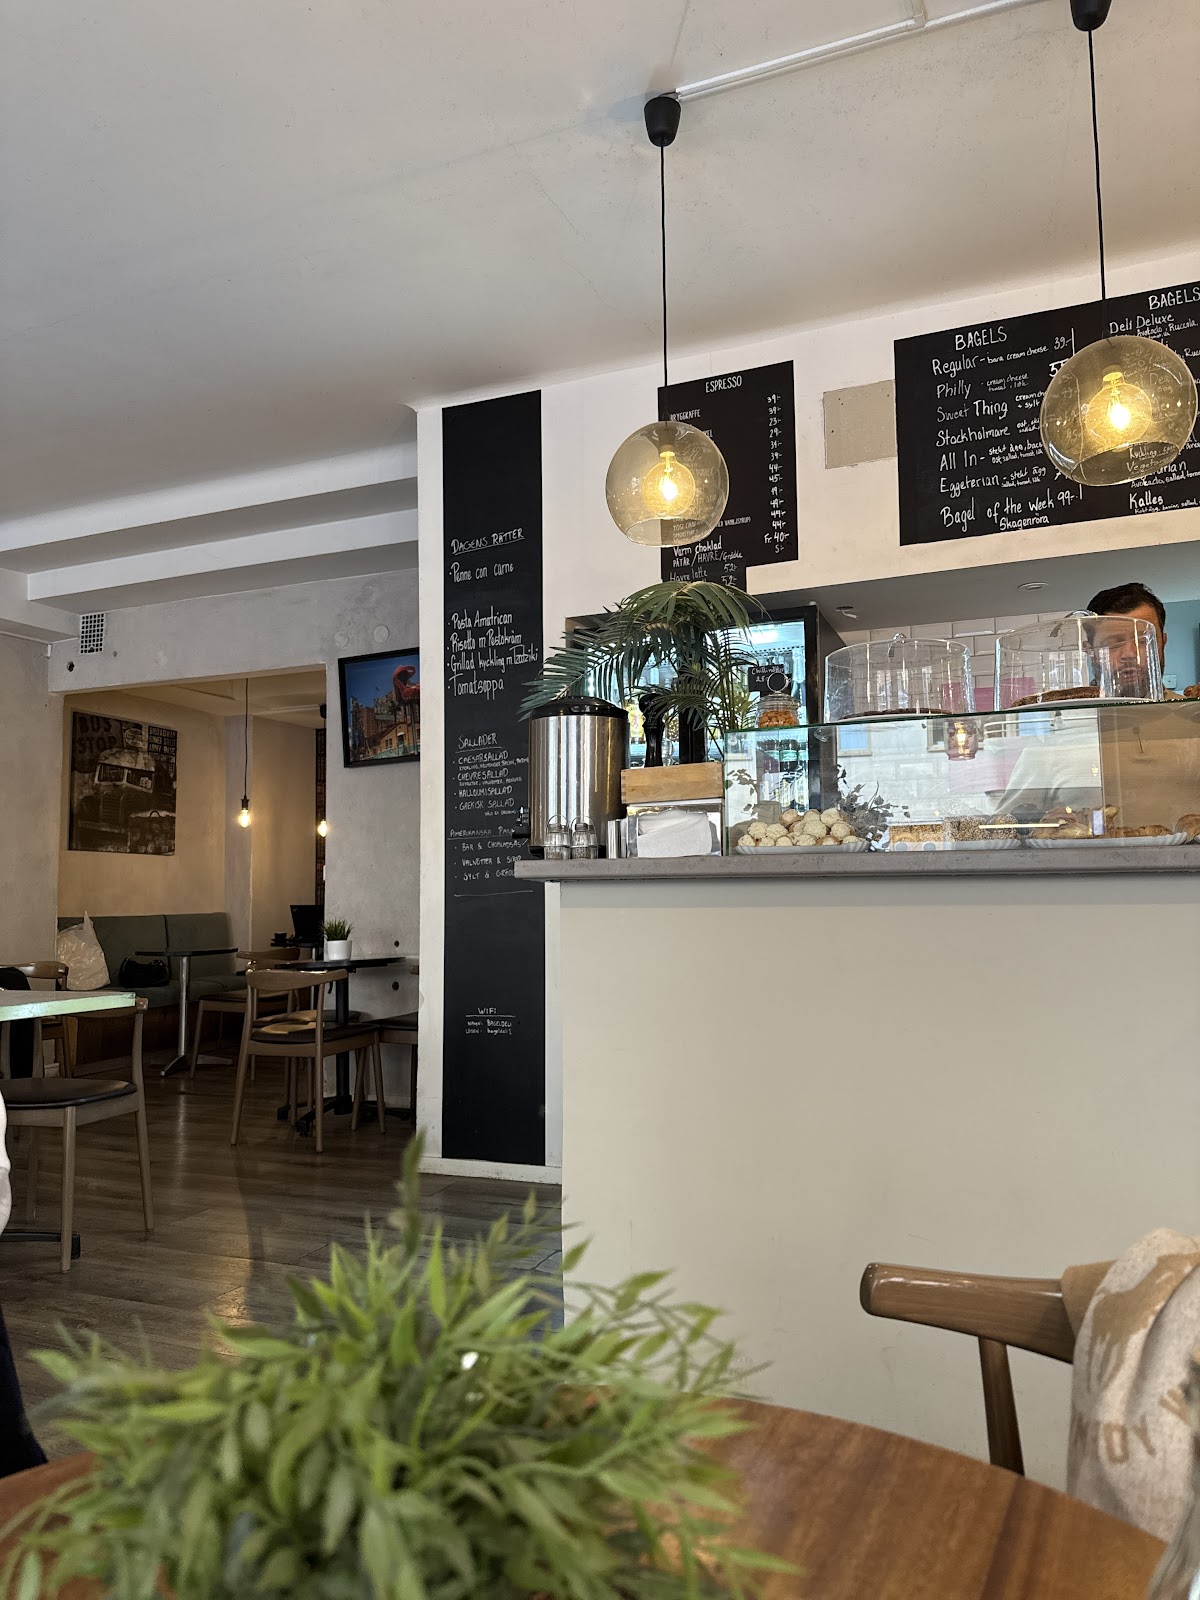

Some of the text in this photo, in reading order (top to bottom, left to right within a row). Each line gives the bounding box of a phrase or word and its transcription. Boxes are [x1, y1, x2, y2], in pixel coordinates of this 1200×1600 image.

[1148, 286, 1200, 310] BAGELS
[1109, 313, 1175, 334] Deli Deluxe
[954, 325, 1008, 351] BAGELS
[932, 353, 979, 378] Regular
[1006, 352, 1026, 361] cream
[1026, 344, 1049, 356] cheese
[705, 374, 743, 394] ESPRESSO
[936, 379, 971, 400] Philly
[936, 399, 1009, 423] Sweet Thing
[936, 426, 1011, 447] Stockholmare
[939, 451, 957, 472] All
[964, 449, 978, 468] In
[939, 474, 1000, 498] Eggeterian
[1129, 490, 1163, 509] Kalles
[939, 496, 976, 533] Bagel
[986, 501, 1001, 524] of
[1003, 496, 1023, 514] the
[999, 512, 1050, 531] Skagenröra
[450, 527, 525, 554] DAGENS RÄTTER
[673, 545, 692, 557] Varm
[695, 535, 723, 554] choklad
[450, 561, 514, 583] Penne con carne
[451, 605, 513, 630] Pasta Amatrican
[450, 630, 475, 653] Risotto
[478, 636, 486, 648] m
[450, 651, 475, 675] Grillad
[478, 647, 505, 674] kyckling
[449, 669, 504, 701] Tomatsoppa
[458, 732, 498, 749] SALLADER
[487, 797, 515, 809] SALLAD
[463, 872, 480, 881] SYLT
